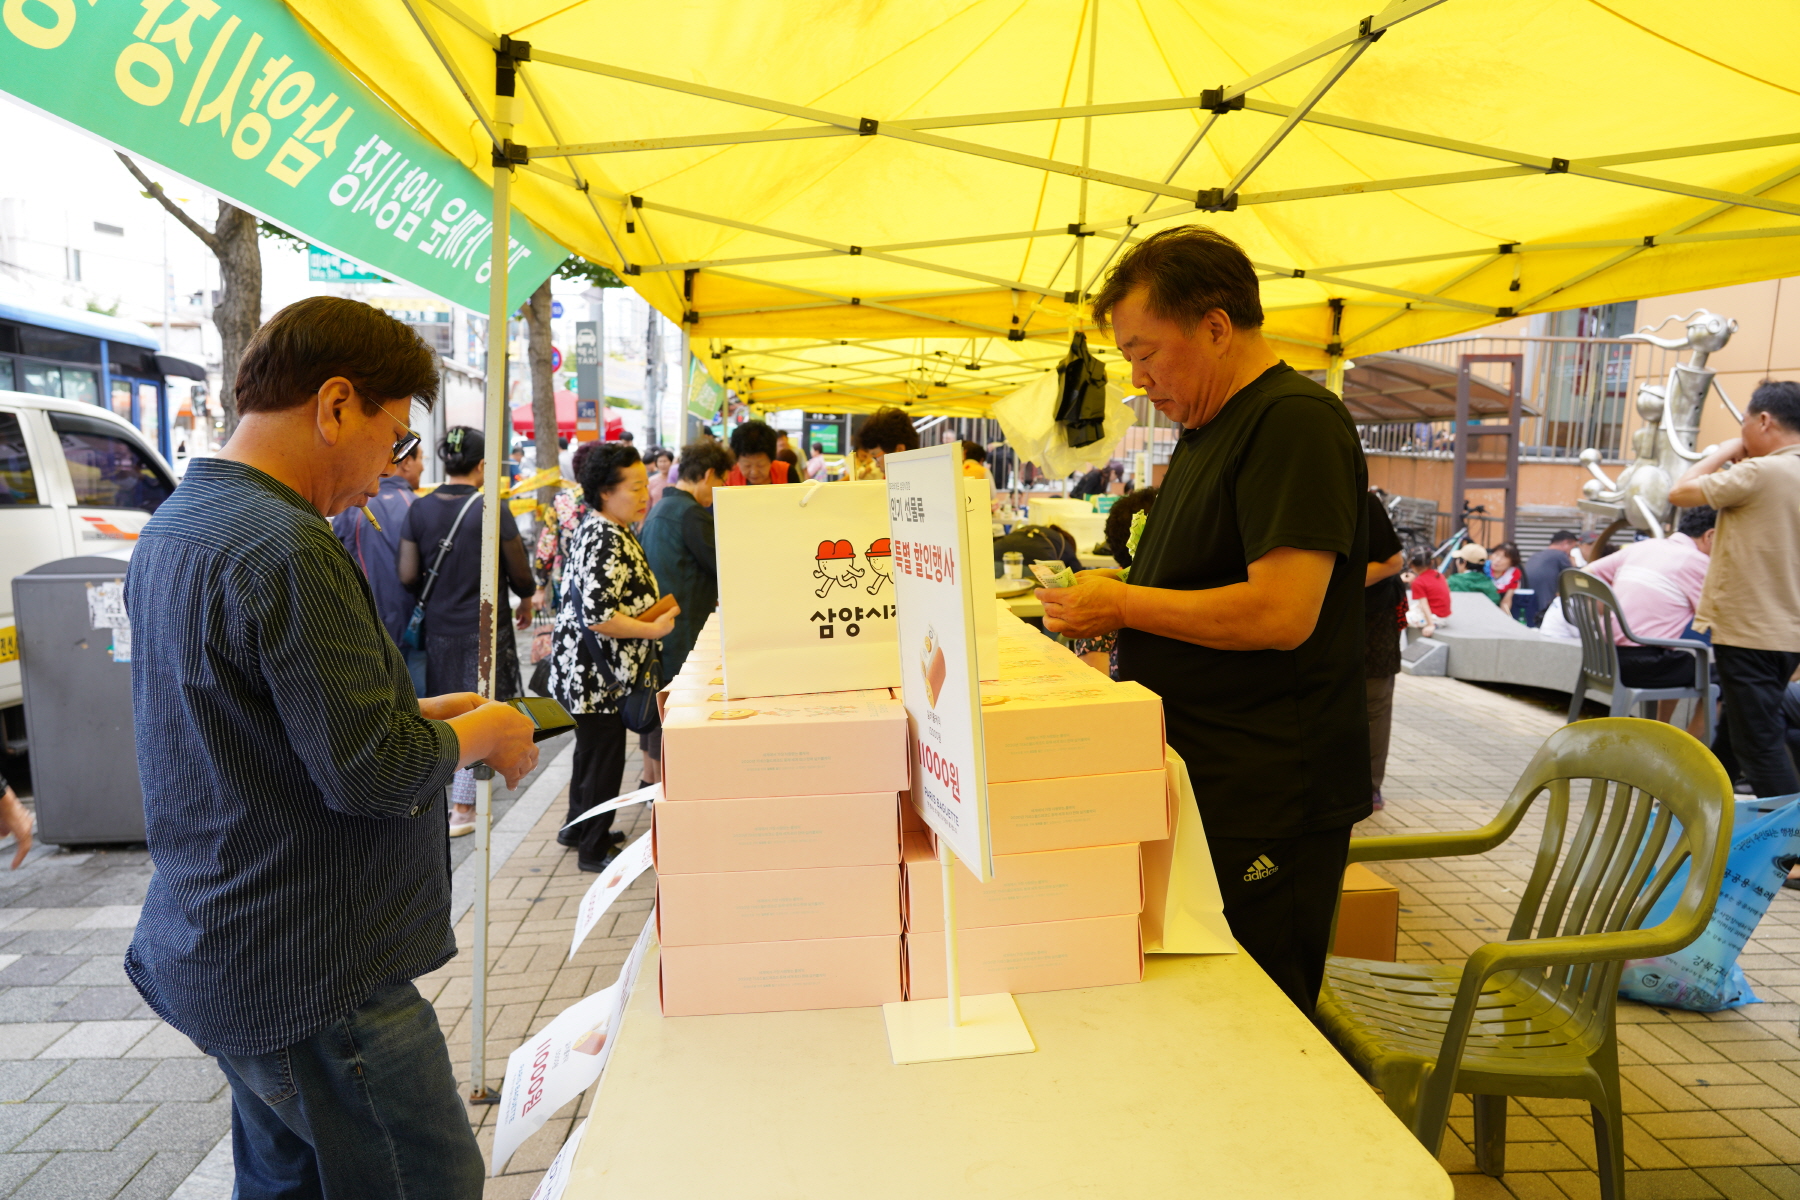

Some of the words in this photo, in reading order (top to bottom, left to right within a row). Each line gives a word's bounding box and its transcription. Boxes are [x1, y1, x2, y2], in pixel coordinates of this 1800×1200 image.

[577, 357, 598, 366] TAXI
[890, 497, 904, 522] 인기
[905, 497, 925, 523] 선물류
[894, 540, 912, 575] 특별
[913, 542, 955, 585] 할인행사
[810, 604, 896, 639] 삼양시
[917, 739, 961, 803] 11000원
[923, 786, 937, 805] PARIS
[936, 797, 960, 827] BAGUETTE
[1243, 865, 1279, 882] adidas
[522, 1038, 552, 1117] 11000원
